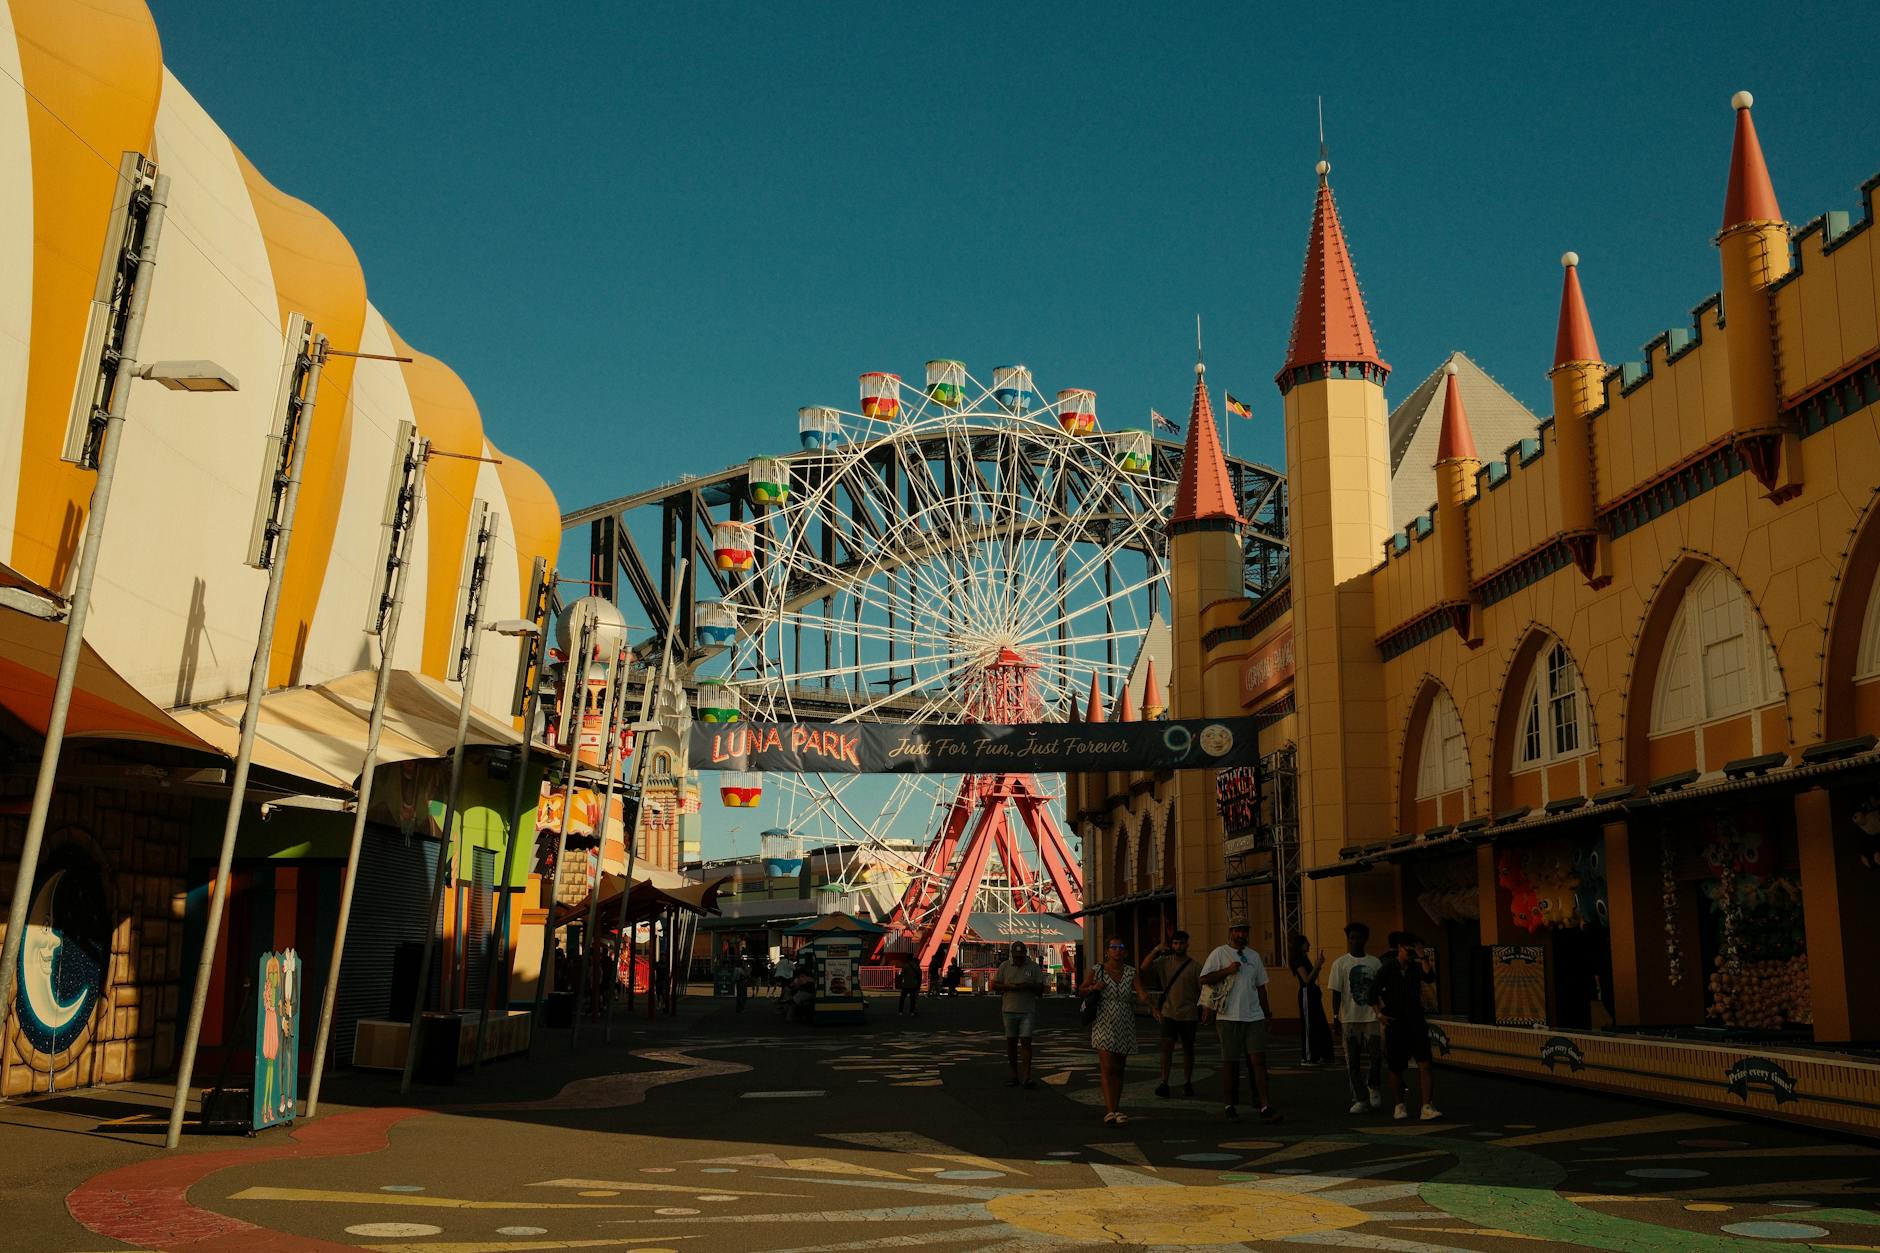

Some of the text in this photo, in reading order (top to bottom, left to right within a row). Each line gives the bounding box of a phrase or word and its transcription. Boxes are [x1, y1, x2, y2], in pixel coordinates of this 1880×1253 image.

[711, 726, 861, 767] LUNA PARK
[888, 736, 1129, 758] Just For Fun, Just Forever
[1748, 1068, 1769, 1081] every
